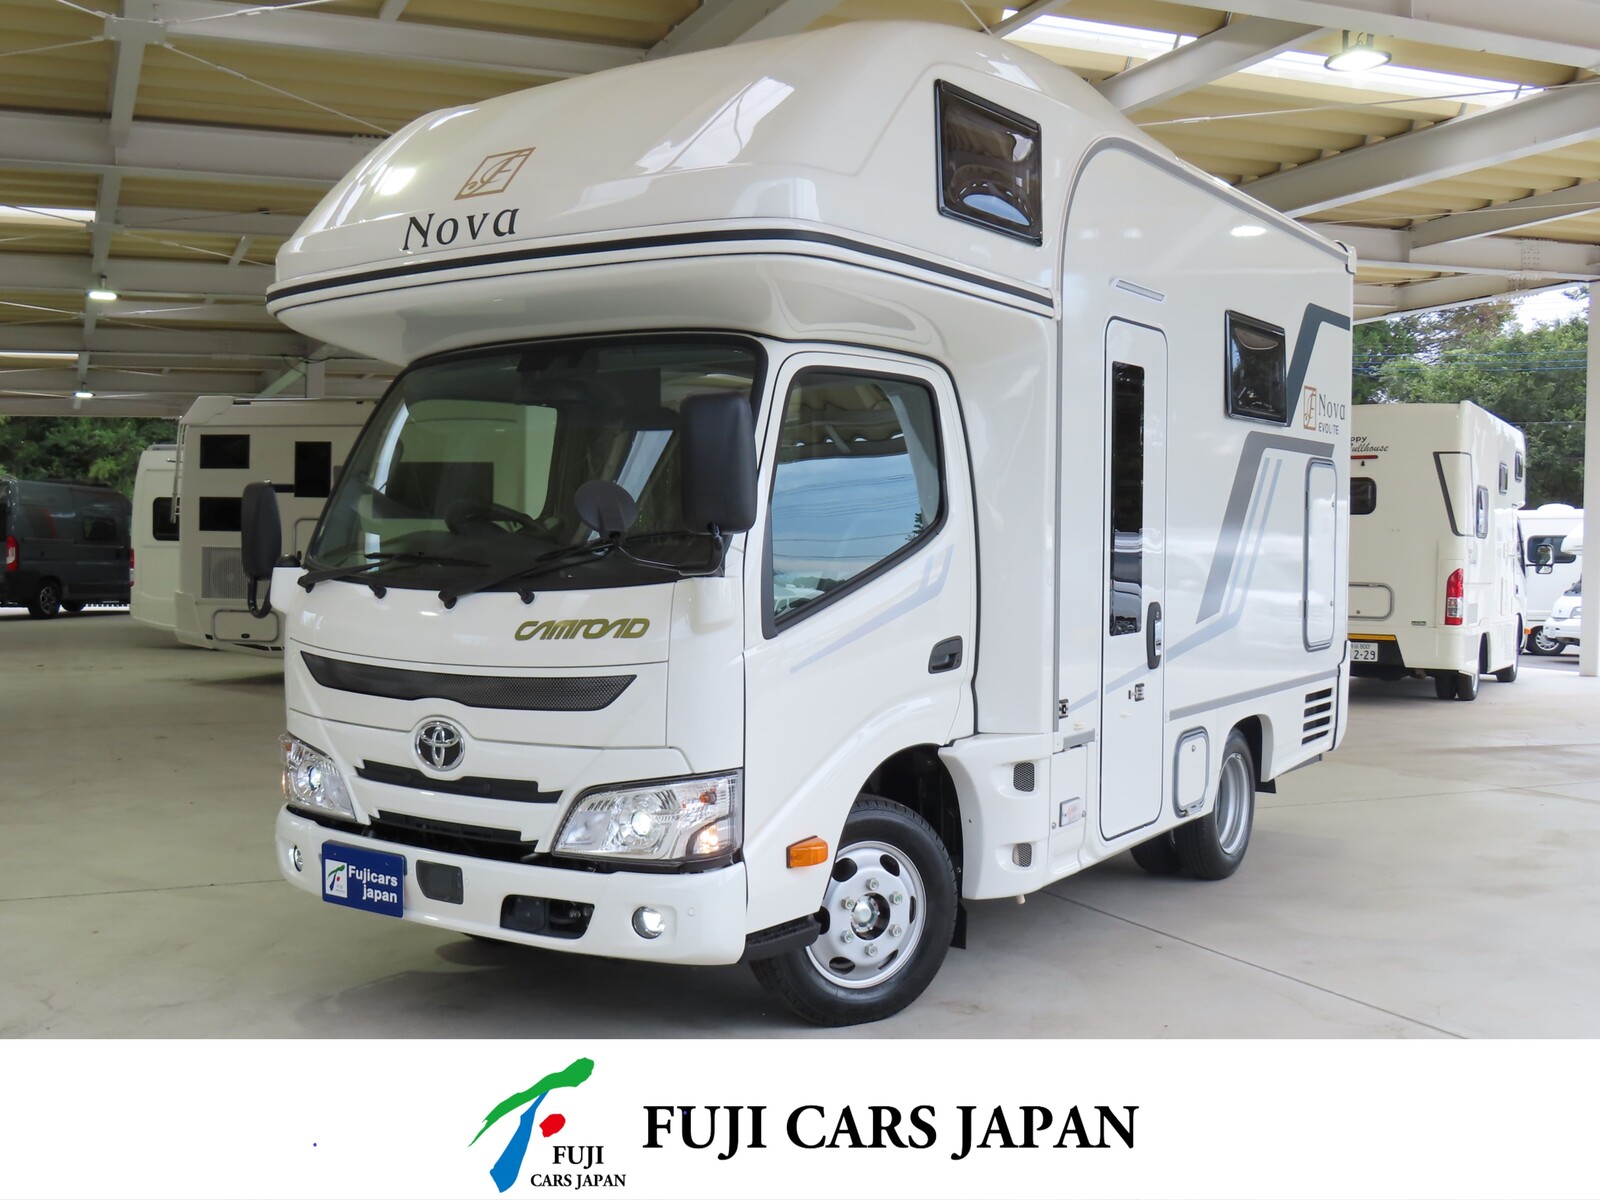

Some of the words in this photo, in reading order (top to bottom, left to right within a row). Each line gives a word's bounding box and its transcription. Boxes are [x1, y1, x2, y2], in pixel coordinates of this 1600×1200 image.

[402, 208, 520, 251] Nova
[1318, 393, 1346, 421] Nova
[1318, 422, 1339, 435] EVOLTE
[514, 617, 650, 641] CAMROAD
[348, 864, 398, 887] Fujicars
[362, 884, 398, 903] japan
